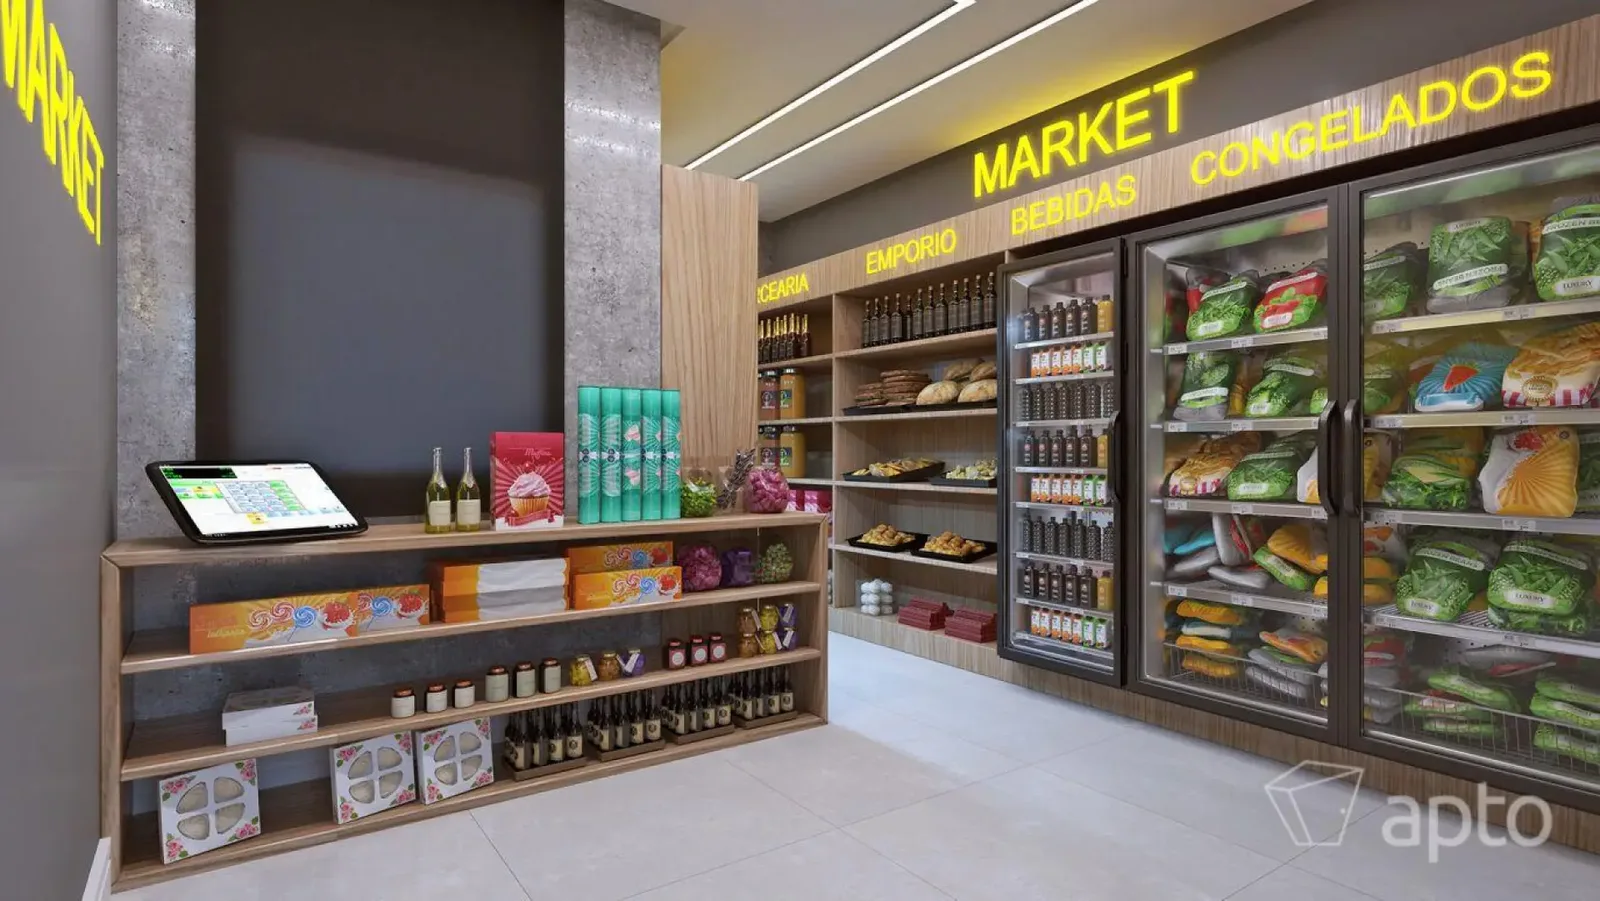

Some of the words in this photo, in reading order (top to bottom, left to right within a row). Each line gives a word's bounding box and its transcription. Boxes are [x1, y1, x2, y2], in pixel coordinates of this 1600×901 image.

[973, 70, 1195, 198] MARKET
[1190, 51, 1552, 186] CONGELADOS
[865, 228, 958, 275] EMPORIO
[1010, 175, 1137, 236] BEBIDAS
